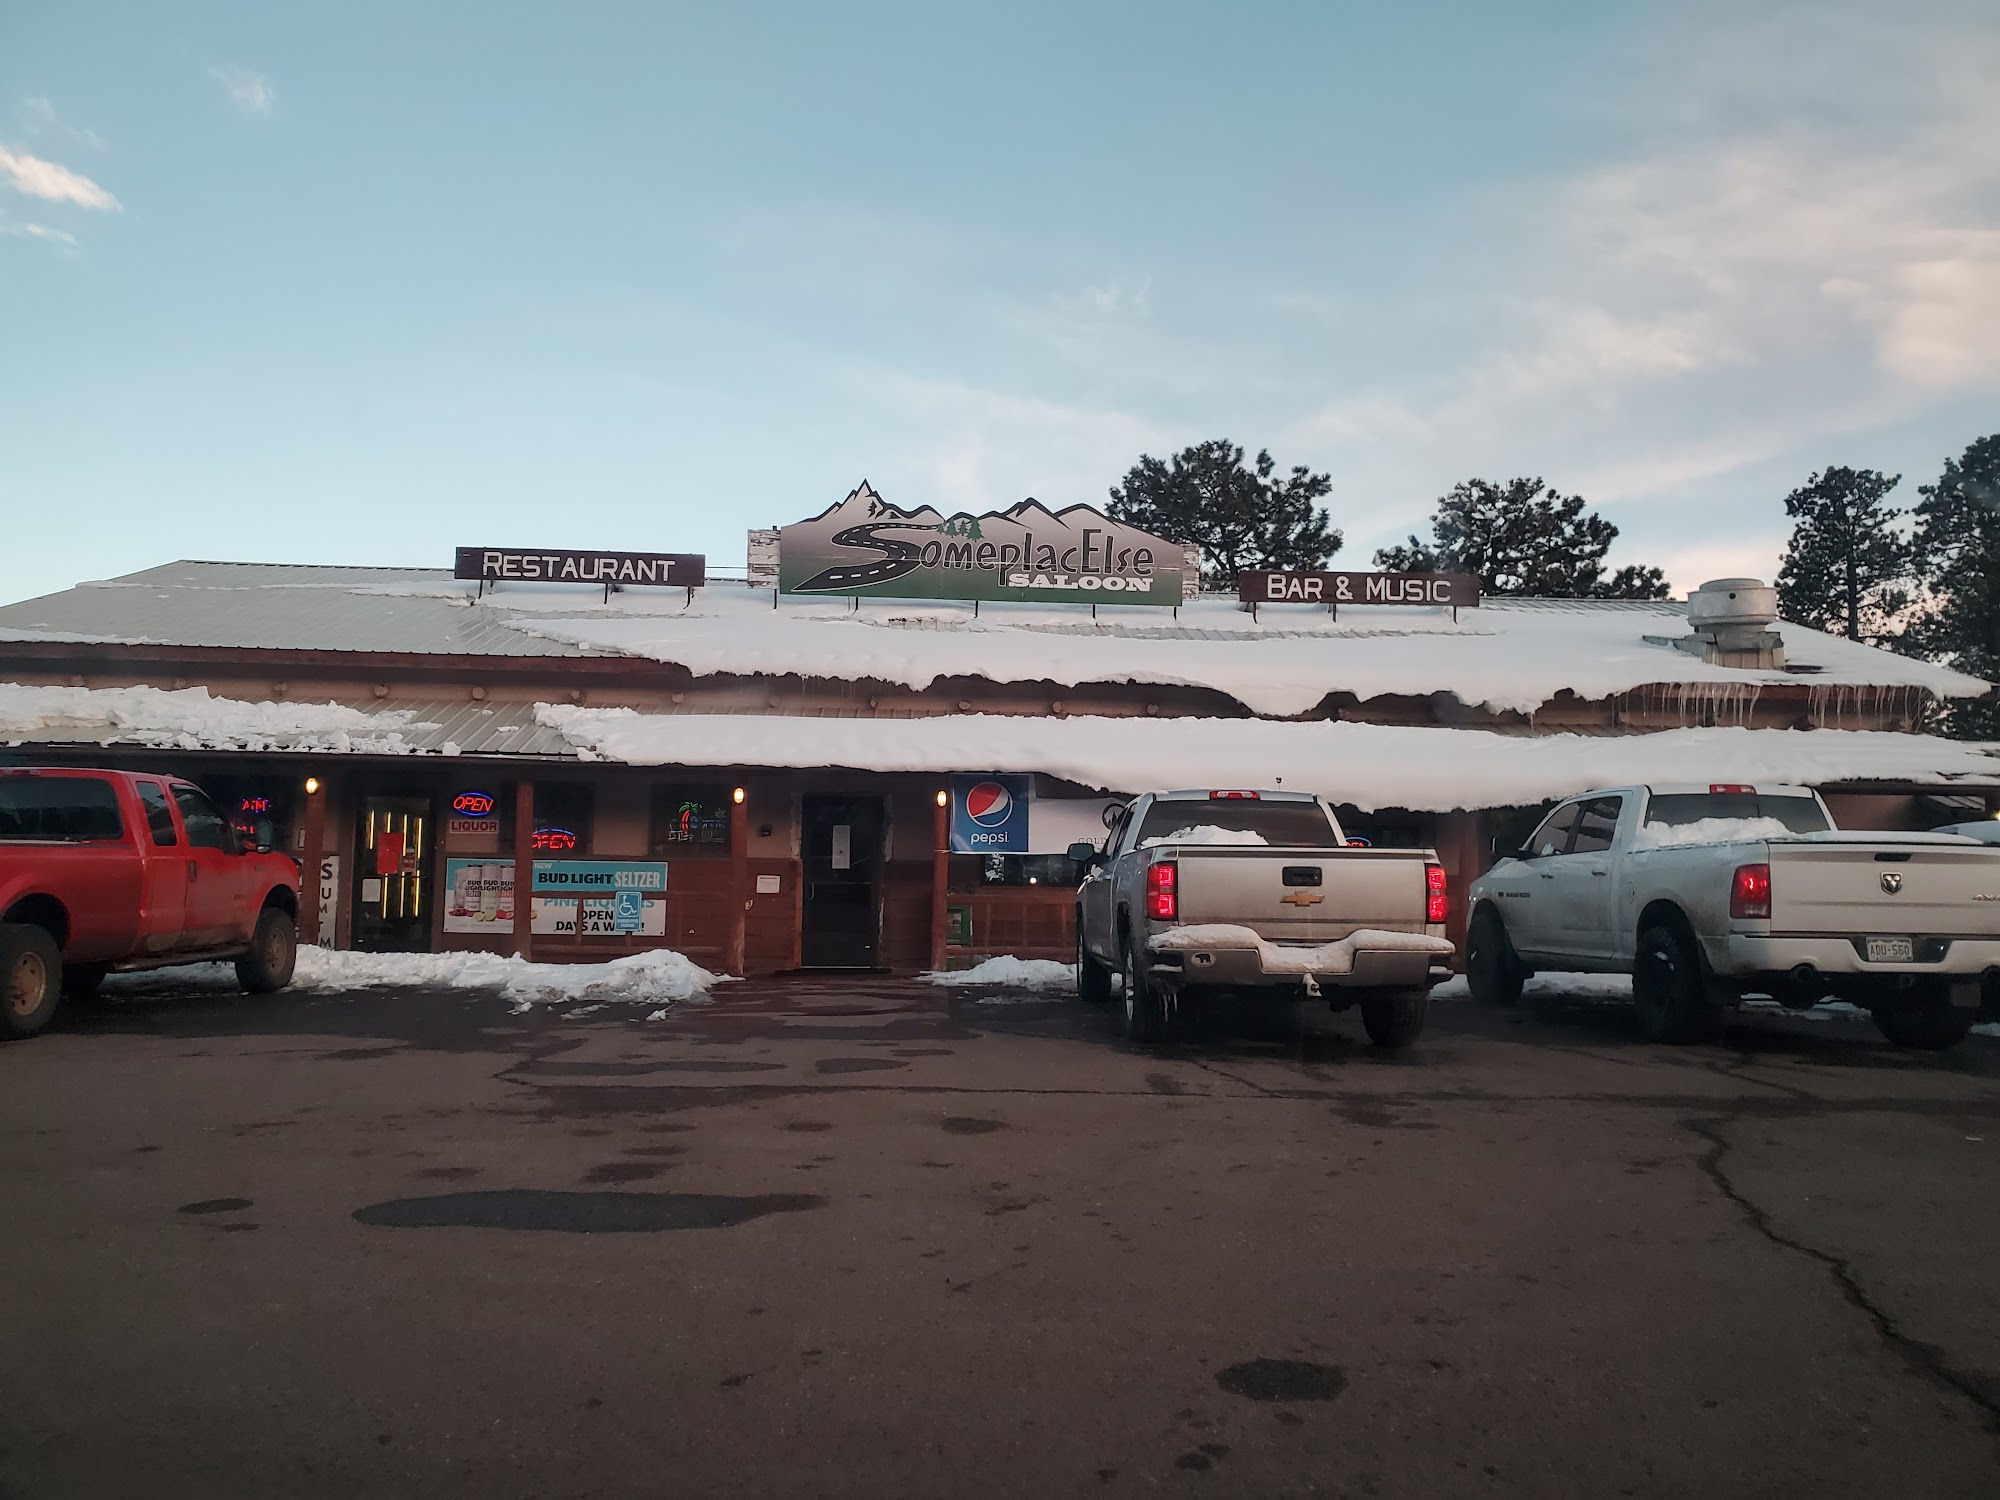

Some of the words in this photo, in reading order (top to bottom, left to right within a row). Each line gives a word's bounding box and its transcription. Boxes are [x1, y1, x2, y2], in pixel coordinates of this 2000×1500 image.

[483, 551, 676, 582] RESTAURANT
[1008, 573, 1154, 592] SALOON
[1267, 574, 1323, 600] BAR
[1336, 575, 1354, 600] &
[1366, 576, 1452, 603] MUSIC
[453, 796, 494, 812] OPEN
[451, 821, 497, 831] LIQUOR
[970, 831, 1009, 845] pepsi
[534, 862, 553, 870] NEW
[538, 872, 569, 884] BUD
[571, 873, 614, 884] LIGHT
[614, 870, 661, 888] SELTZER
[591, 921, 601, 932] A
